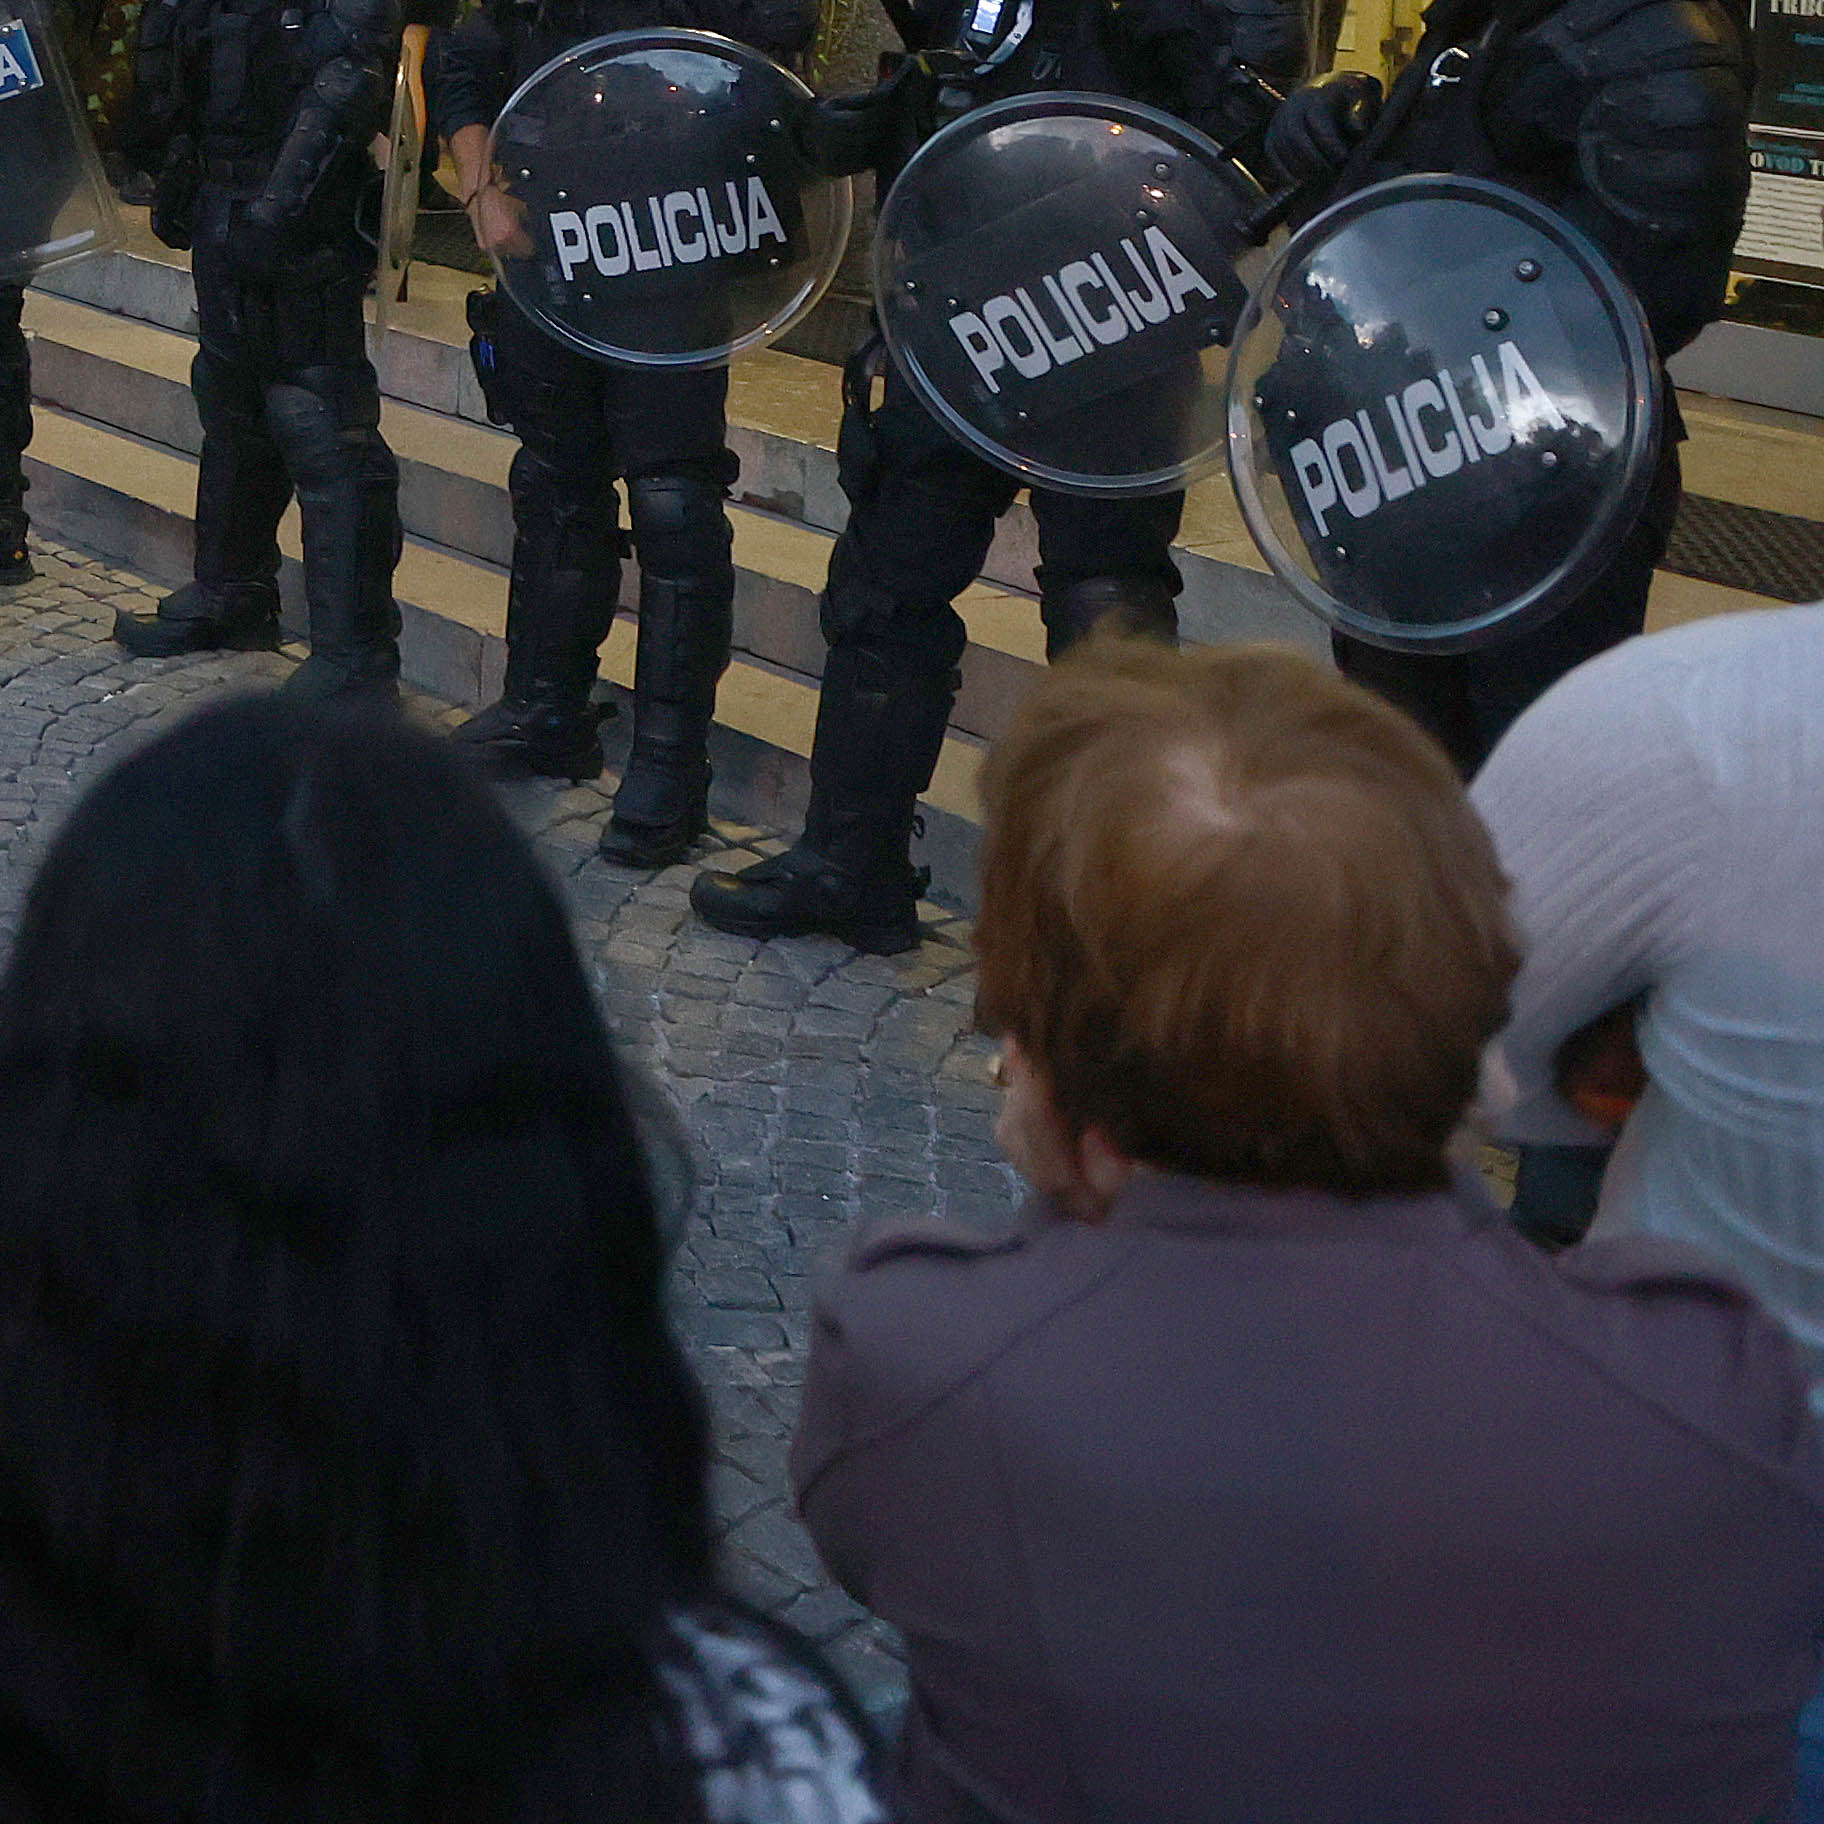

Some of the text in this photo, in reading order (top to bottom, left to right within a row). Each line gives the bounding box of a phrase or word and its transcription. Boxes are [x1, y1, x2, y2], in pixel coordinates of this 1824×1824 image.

[549, 176, 788, 282] POLICIJA
[949, 225, 1218, 394] POLICIJA
[1289, 340, 1568, 538] POLICIJA
